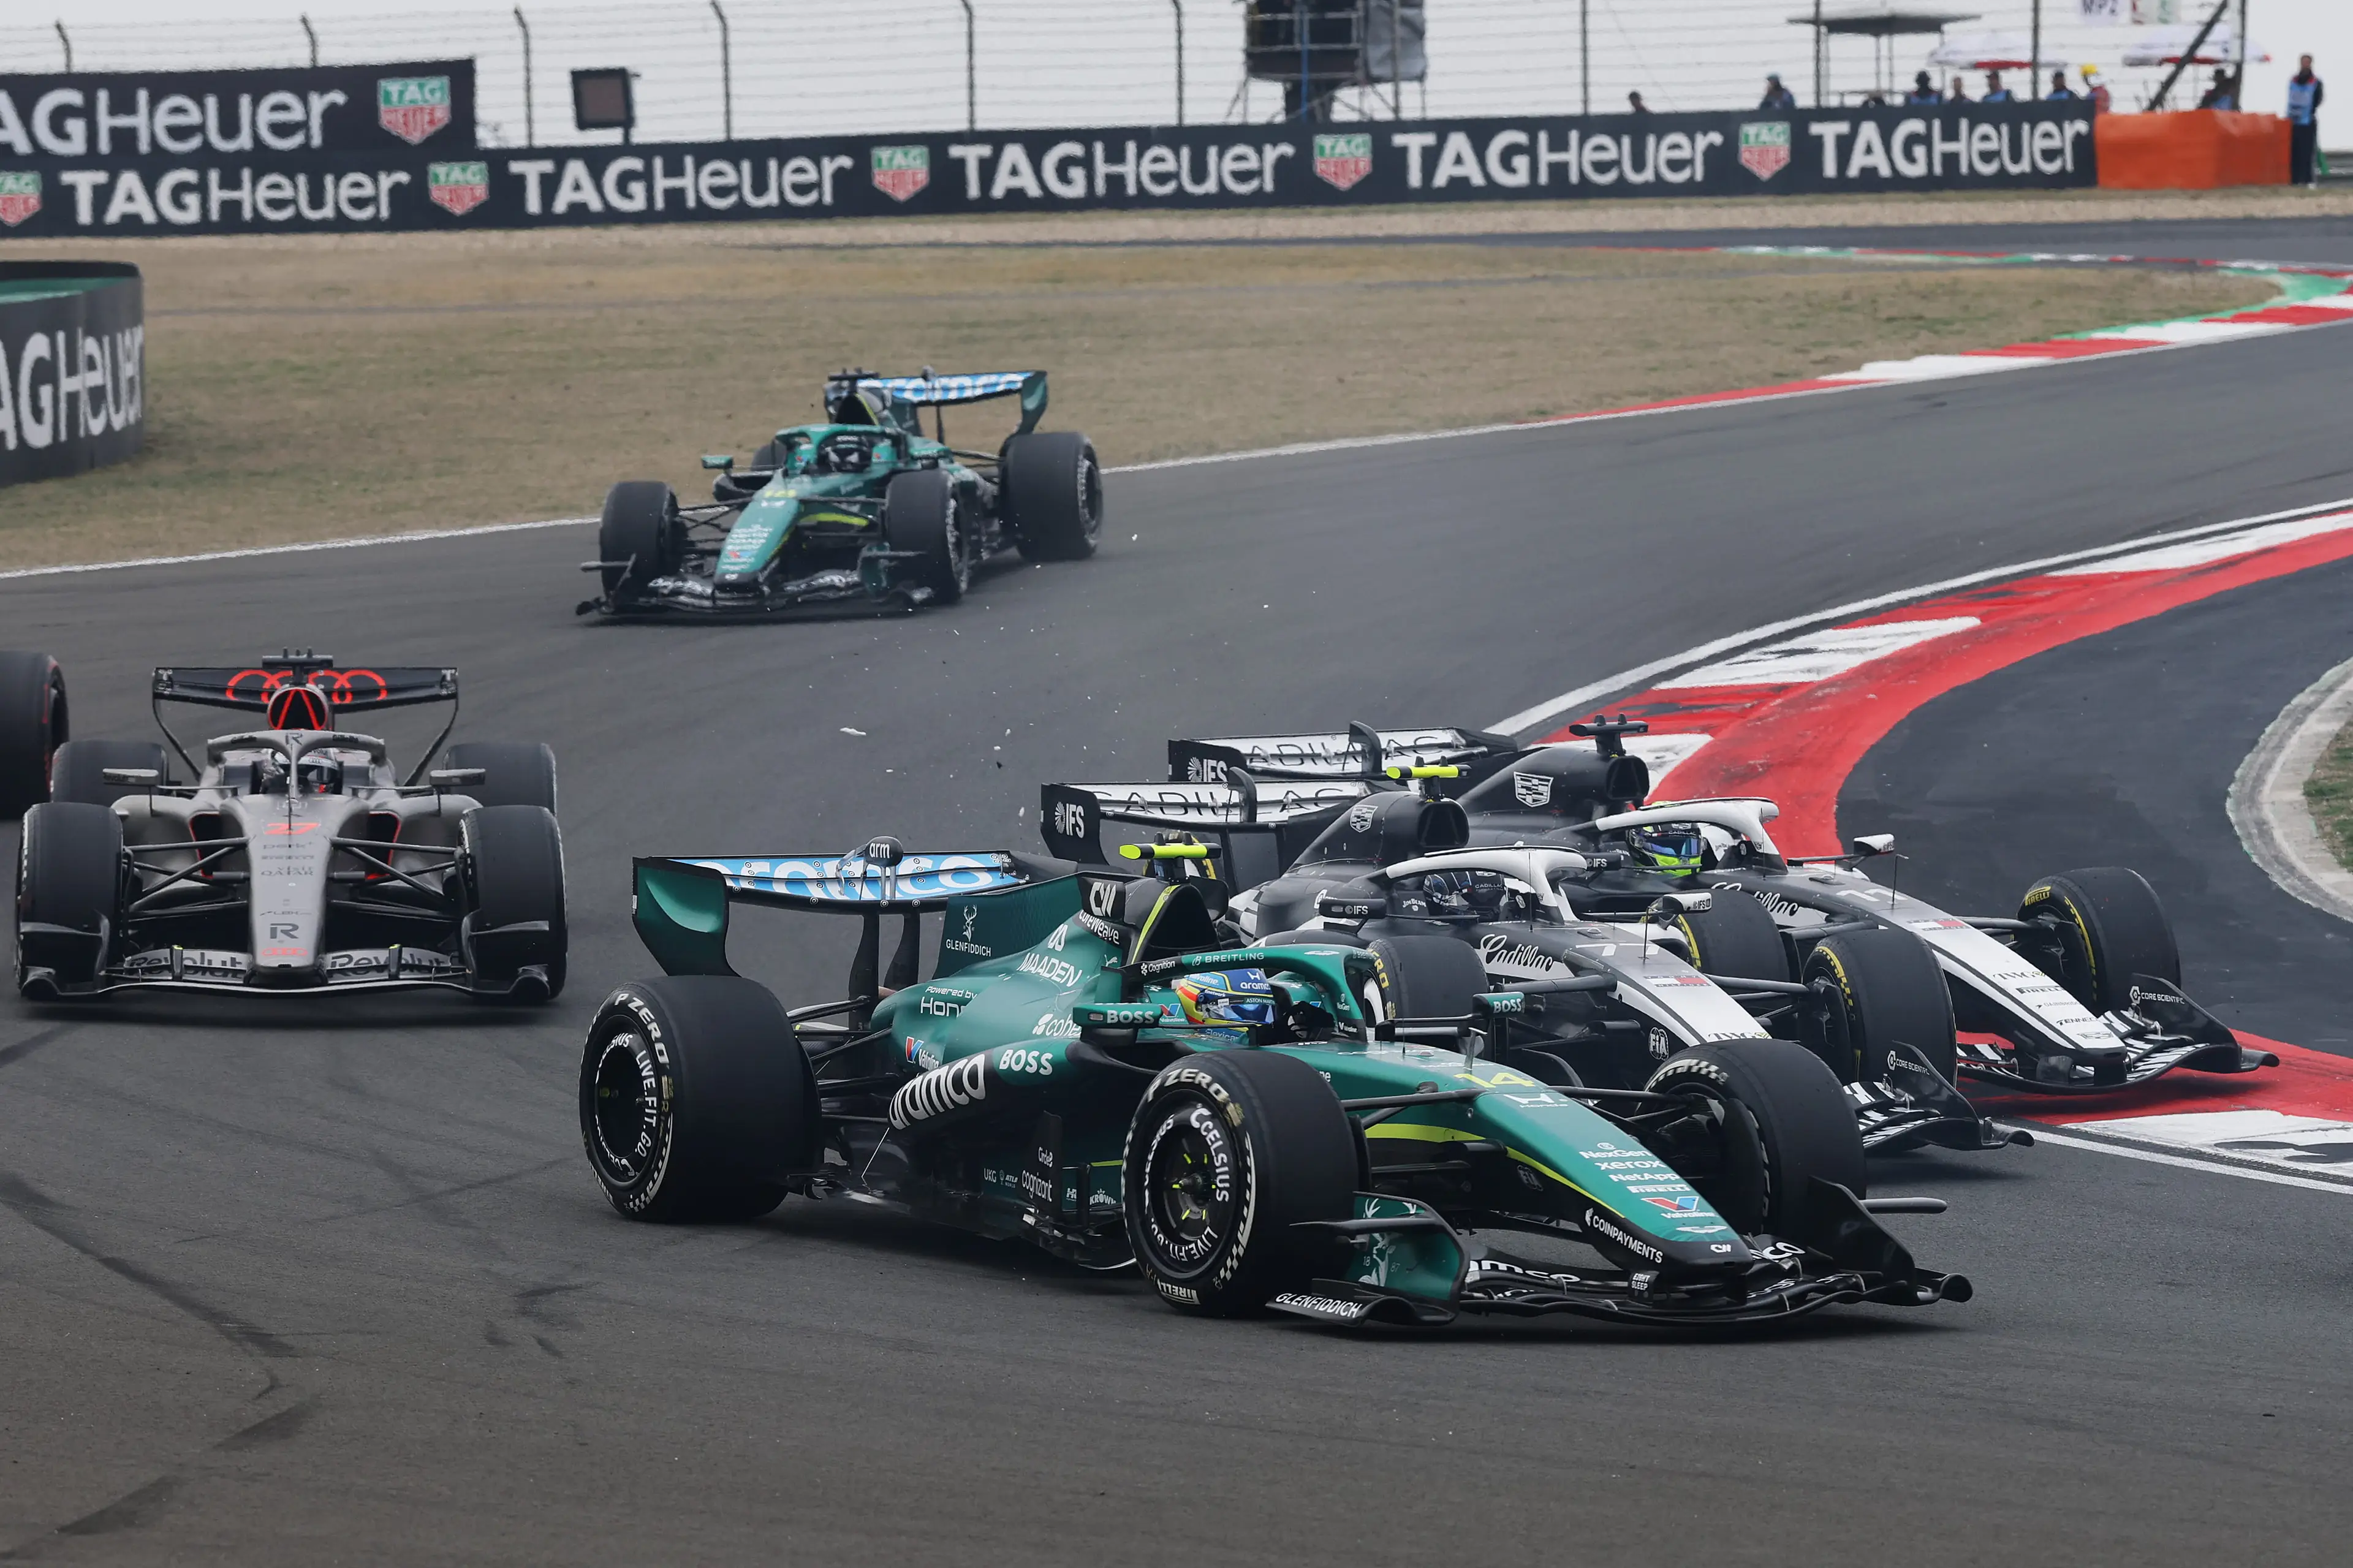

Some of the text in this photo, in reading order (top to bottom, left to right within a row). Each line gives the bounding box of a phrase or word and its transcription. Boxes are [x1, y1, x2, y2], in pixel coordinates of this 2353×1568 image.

[264, 823, 319, 835] 27
[1066, 804, 1085, 838] IFS
[869, 842, 890, 859] arm
[1593, 858, 1607, 868] IFS
[1353, 905, 1369, 915] IFS
[1697, 900, 1706, 909] IFS
[270, 923, 299, 939] R
[946, 938, 991, 958] GLENFIDDICH
[1480, 933, 1554, 972] Cadillac
[1205, 952, 1265, 964] BREITLING
[1016, 952, 1083, 987] MAADEN
[1148, 960, 1175, 974] Cognition
[925, 986, 978, 999] Powered by
[2141, 992, 2157, 1001] CORE
[920, 996, 968, 1018] Hon
[1493, 998, 1521, 1013] BOSS
[1107, 1010, 1154, 1024] BOSS
[614, 993, 670, 1064] P ZERO
[1650, 1029, 1669, 1058] FIA
[999, 1049, 1053, 1076] BOSS
[1896, 1058, 1908, 1069] CORE
[1164, 1068, 1230, 1104] ZERO
[1453, 1072, 1536, 1088] 14
[888, 1053, 986, 1129] aramco
[1200, 1121, 1230, 1202] CELSIUS
[1578, 1149, 1654, 1159] NexGen
[1594, 1160, 1667, 1170] xerox
[983, 1167, 997, 1183] UKG
[1608, 1172, 1680, 1182] NetApp
[1021, 1169, 1053, 1202] cognizant
[1626, 1184, 1692, 1194] PIRELLI
[1593, 1215, 1664, 1263] COINPAYMENTS
[1362, 1256, 1400, 1273] 18 87
[1632, 1273, 1651, 1282] EIGHT
[1631, 1281, 1648, 1291] SLEEP
[1275, 1293, 1363, 1319] GLENFIDDICH
